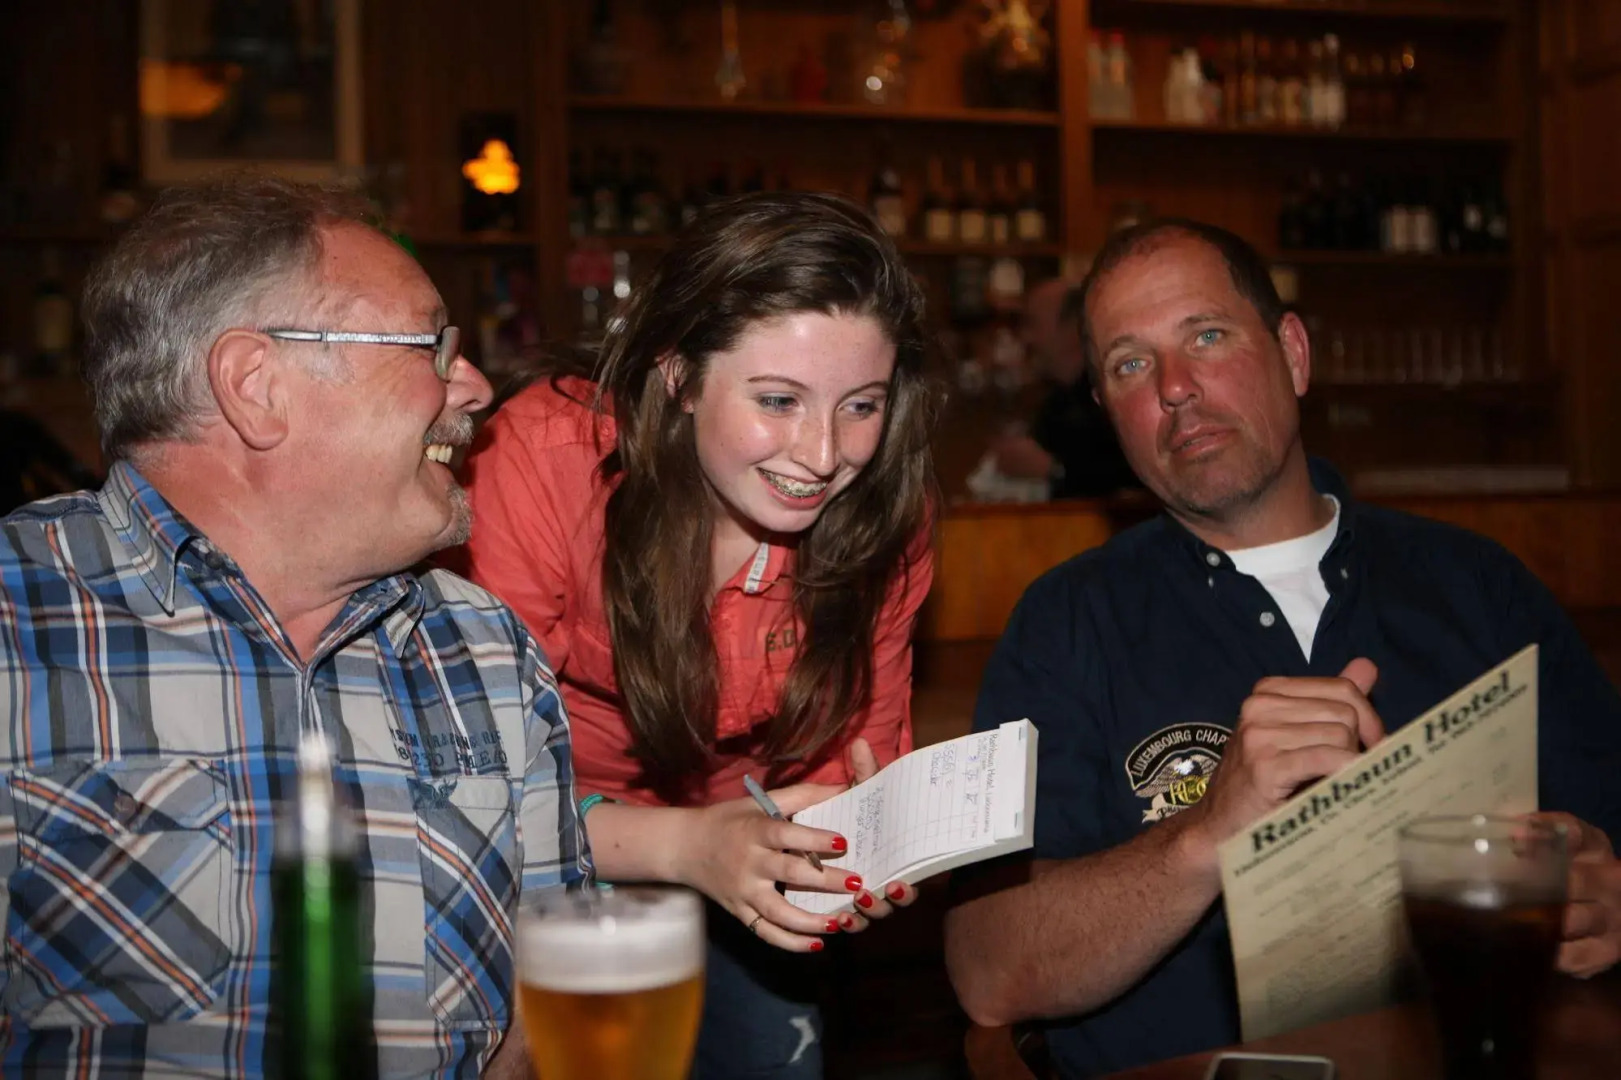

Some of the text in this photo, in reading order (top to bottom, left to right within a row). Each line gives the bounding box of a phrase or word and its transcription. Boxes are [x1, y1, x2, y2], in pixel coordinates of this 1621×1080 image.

[1130, 729, 1231, 777] LUXEMBOURG CHAP
[1251, 743, 1412, 853] Rathbaun
[1424, 671, 1509, 744] Hotel
